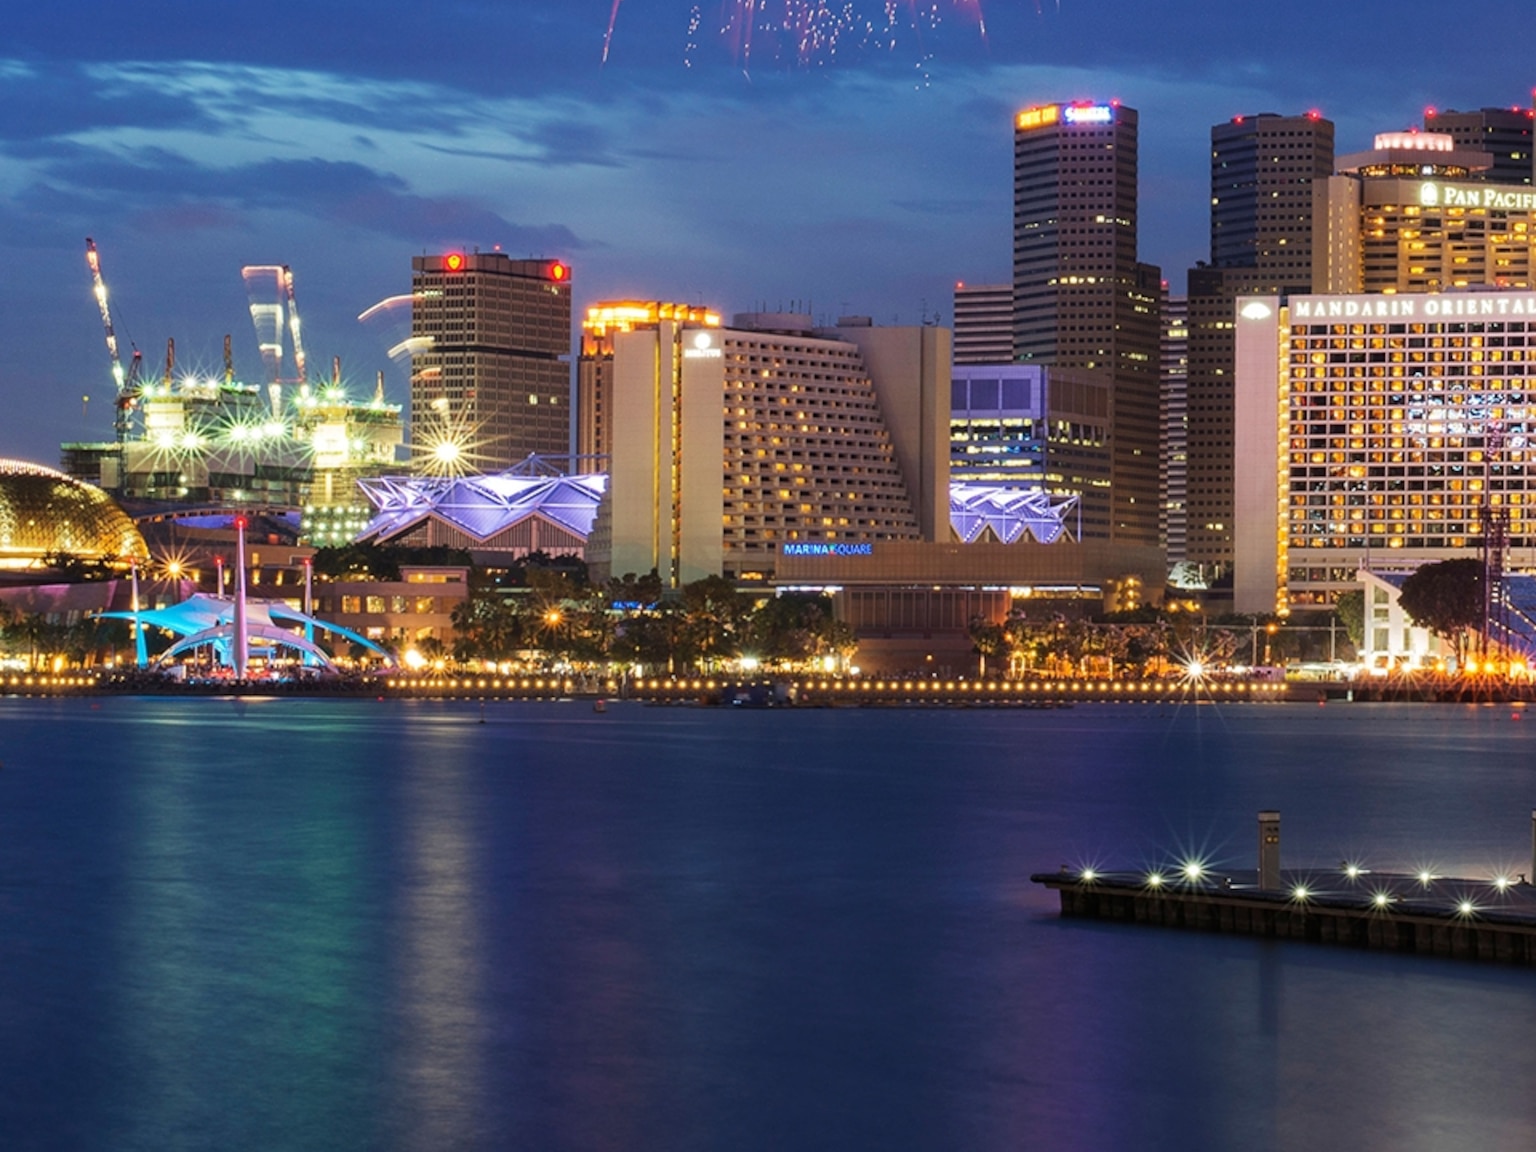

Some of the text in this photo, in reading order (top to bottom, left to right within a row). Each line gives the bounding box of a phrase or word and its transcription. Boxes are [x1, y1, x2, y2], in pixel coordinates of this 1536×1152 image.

[1444, 187, 1479, 206] PAN
[1296, 301, 1414, 317] MANDARIN
[783, 544, 872, 556] MARINA SQUARE
